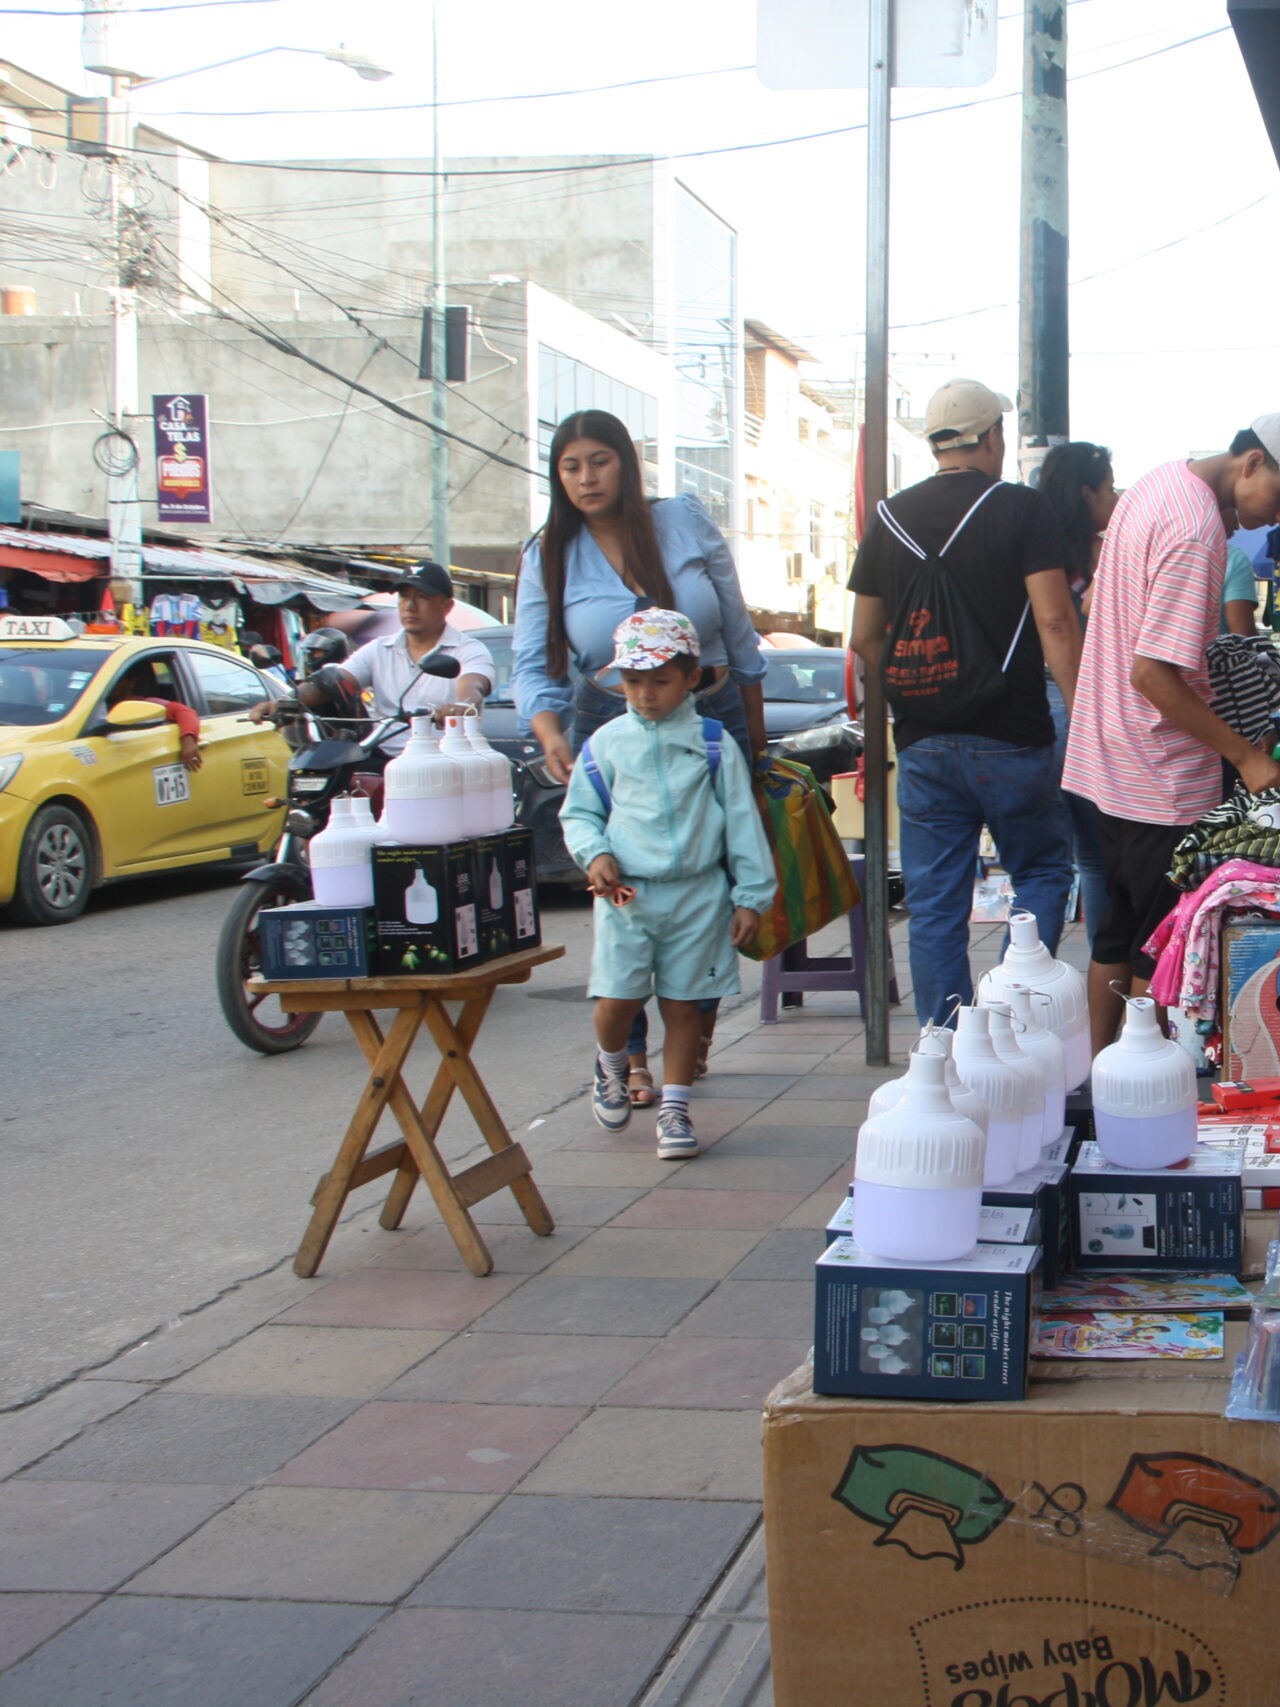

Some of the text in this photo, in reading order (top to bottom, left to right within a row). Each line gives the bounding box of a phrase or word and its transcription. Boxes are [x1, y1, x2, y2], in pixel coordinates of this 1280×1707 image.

[160, 422, 188, 432] CASA
[166, 431, 202, 442] TELAS
[6, 621, 51, 635] TAXI
[990, 1290, 1001, 1351] vendor artifact
[1001, 1290, 1012, 1385] The night market street
[945, 1635, 1114, 1684] Baby wipes
